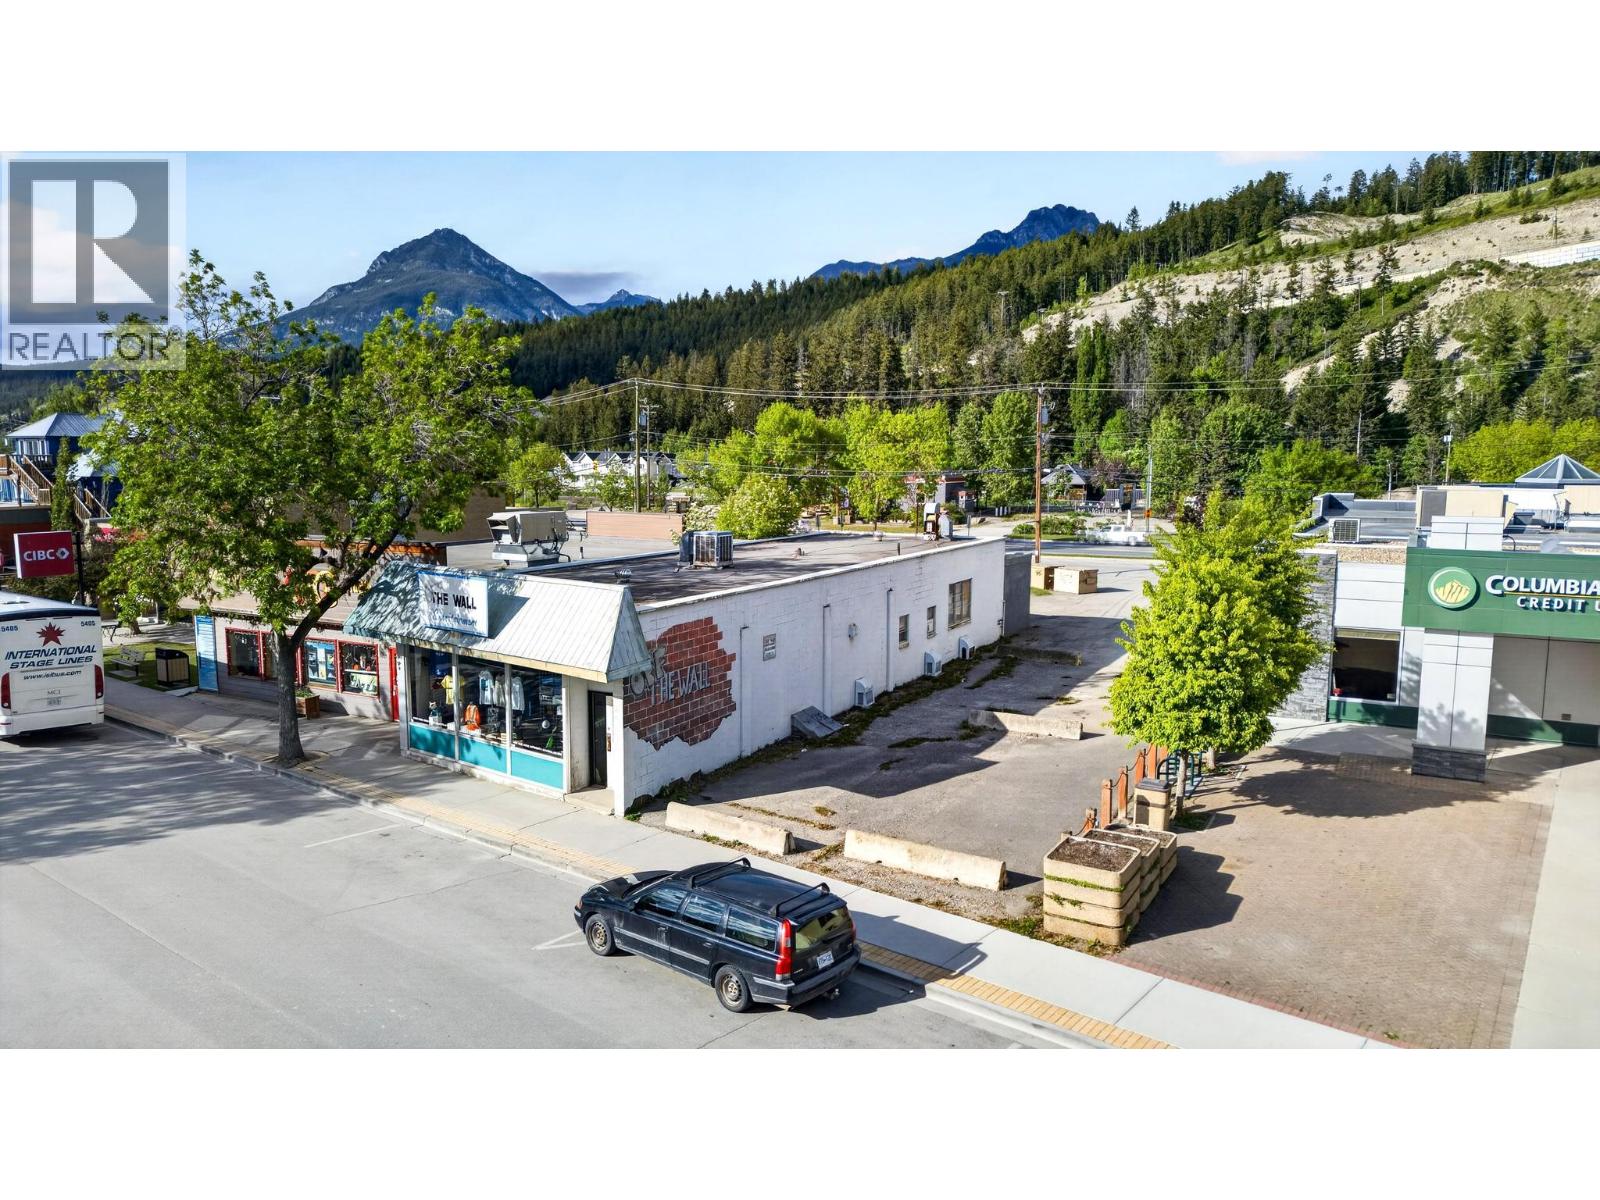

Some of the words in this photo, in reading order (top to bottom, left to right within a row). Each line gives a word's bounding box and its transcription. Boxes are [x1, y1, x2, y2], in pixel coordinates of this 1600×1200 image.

[23, 549, 55, 561] CIBC
[1485, 574, 1600, 595] COLUMBIA
[432, 591, 449, 606] THE
[452, 594, 477, 610] WALL
[1516, 596, 1586, 611] CREDIT
[5, 645, 96, 660] INTERNATIONAL
[10, 659, 54, 669] STAGE
[58, 656, 93, 665] LINES
[677, 661, 711, 698] WALL
